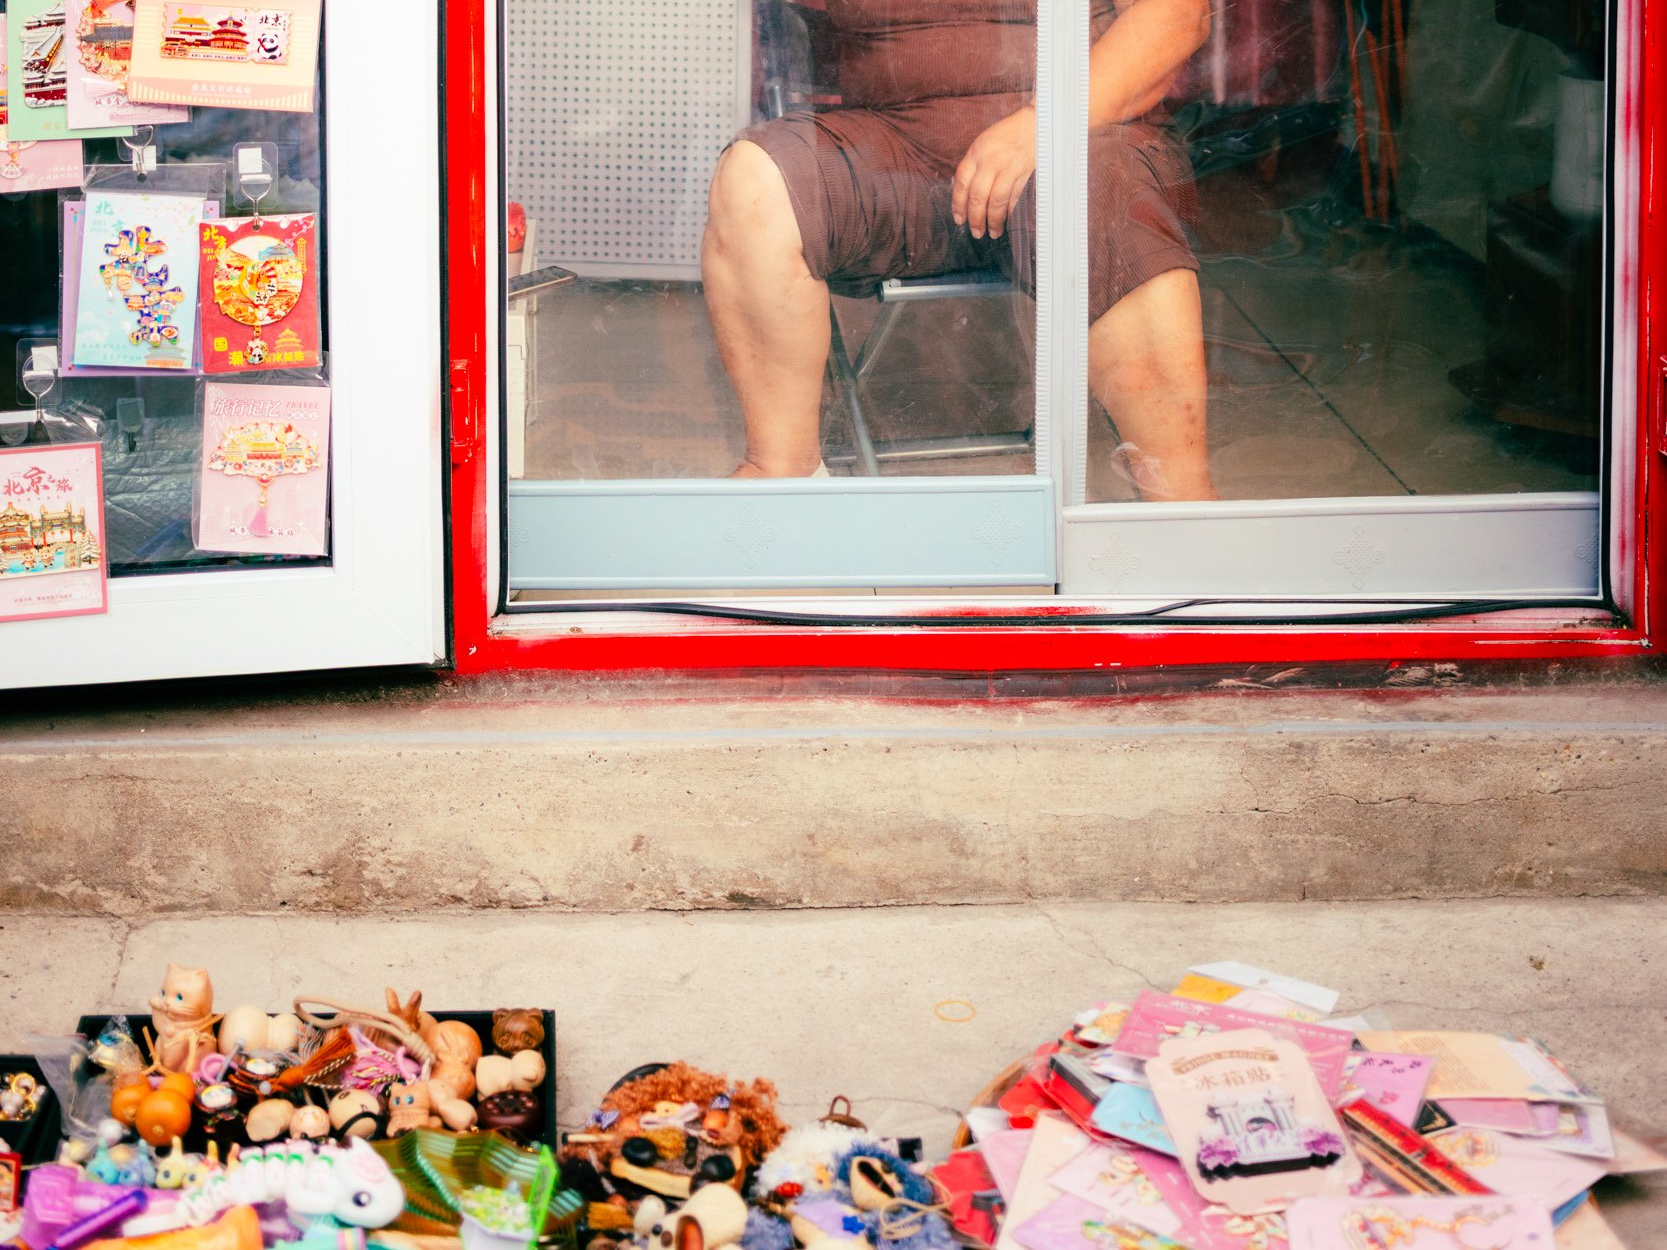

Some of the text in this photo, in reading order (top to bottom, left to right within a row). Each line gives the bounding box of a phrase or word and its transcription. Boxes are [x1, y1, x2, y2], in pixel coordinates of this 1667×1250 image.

[259, 13, 283, 27] 北京
[212, 399, 281, 418] 旅行记忆
[1194, 1066, 1272, 1091] 冰箱贴
